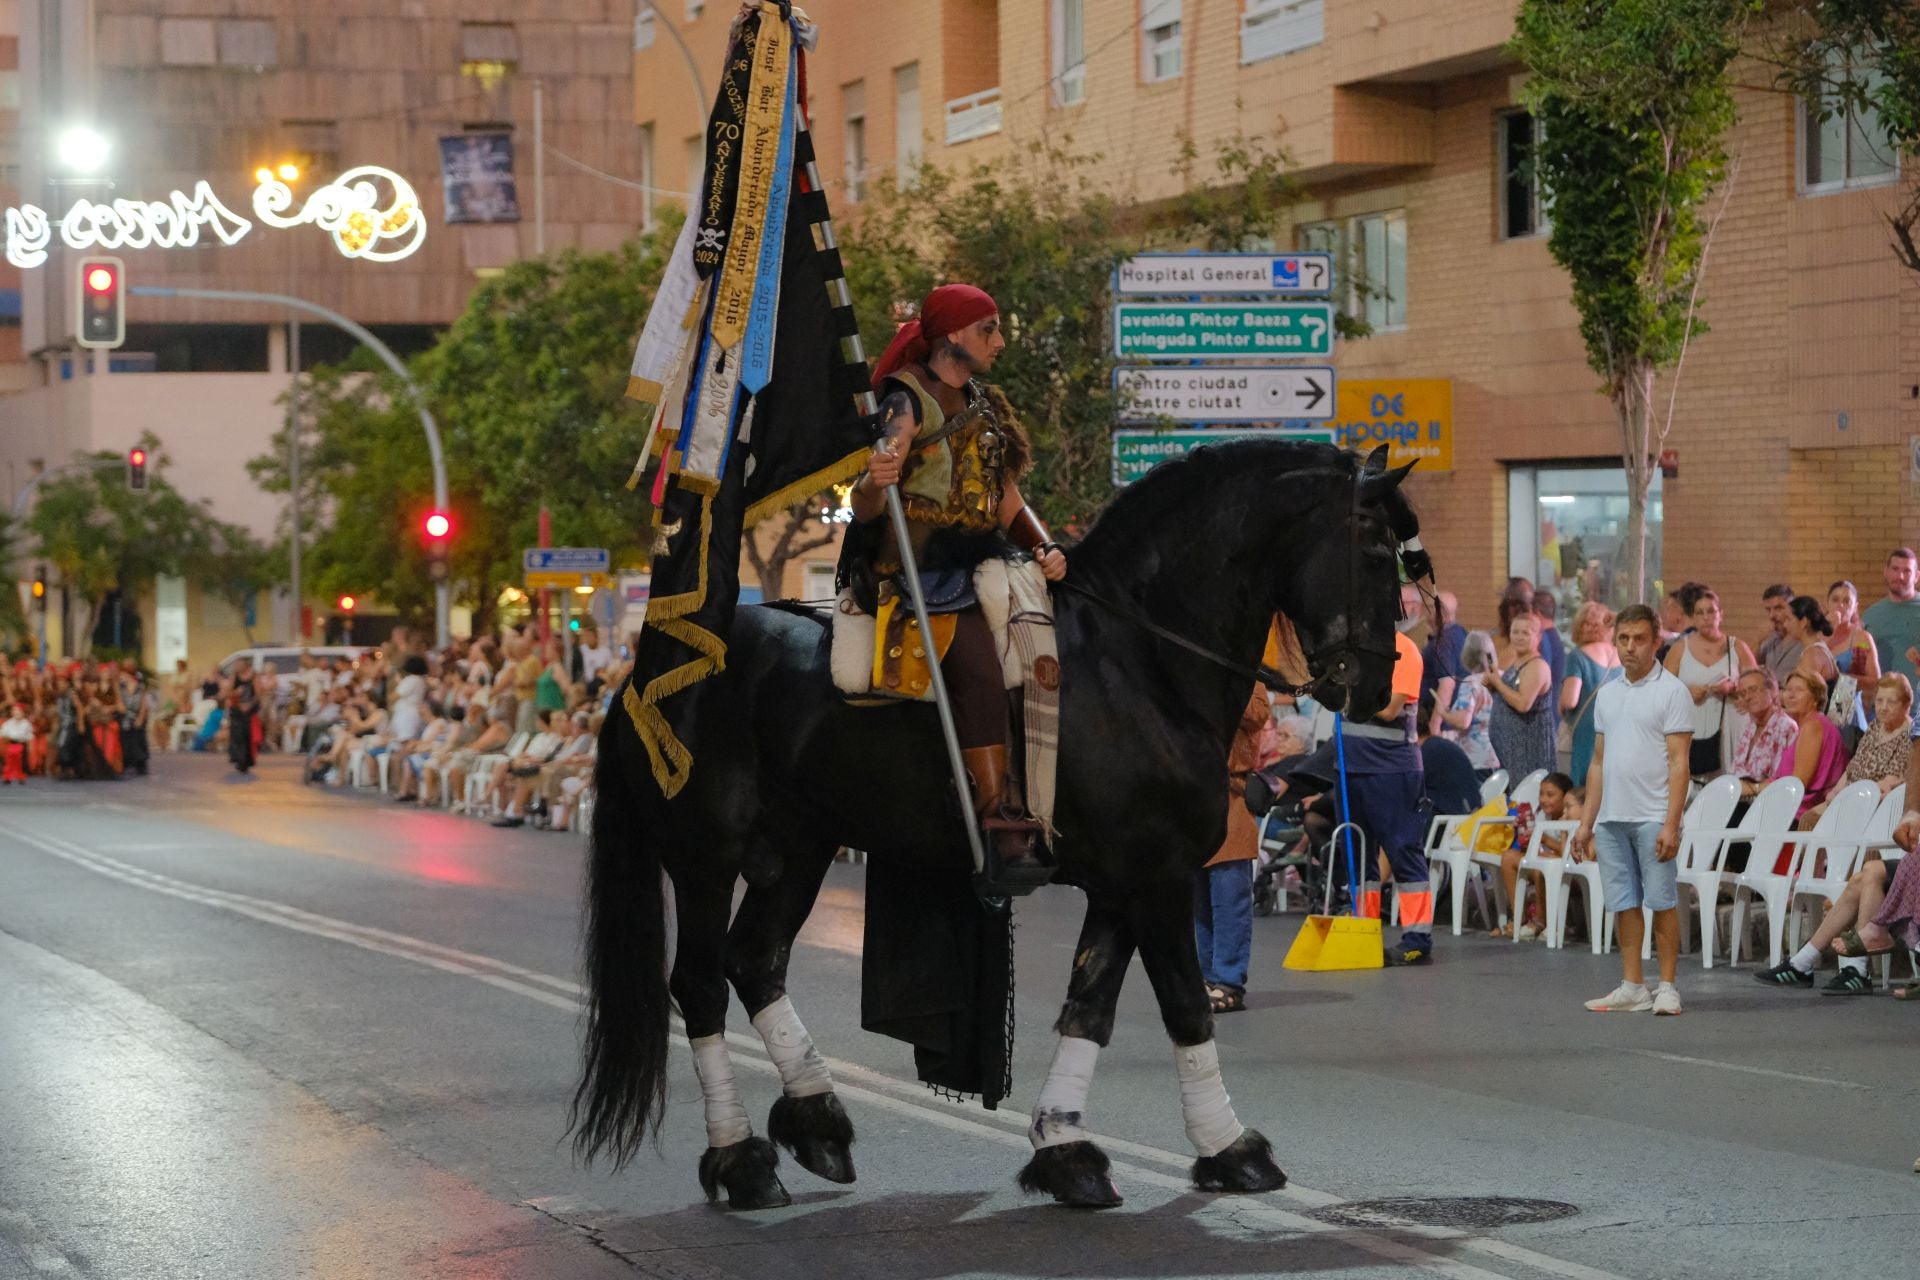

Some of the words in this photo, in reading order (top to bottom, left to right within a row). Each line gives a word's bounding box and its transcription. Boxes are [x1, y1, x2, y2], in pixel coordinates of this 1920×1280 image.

[714, 121, 740, 140] 70
[706, 140, 731, 226] ANIVERSARIO
[748, 125, 770, 219] Abanderado
[695, 249, 720, 264] 2024
[735, 224, 755, 275] Mayor
[1121, 265, 1195, 284] Hospital
[1202, 265, 1267, 281] General
[726, 289, 742, 326] 2016
[751, 283, 771, 369] 2015-2016
[1122, 313, 1186, 328] avenida
[1190, 313, 1239, 328] Pintor
[1244, 313, 1291, 328] Baeza
[1122, 333, 1197, 350] avinguda
[1201, 333, 1250, 347] Pintor
[1255, 333, 1302, 347] Baeza
[1188, 376, 1248, 390] ciudad
[708, 373, 729, 418] 2006
[1188, 395, 1243, 409] ciutat
[1371, 393, 1405, 418] DE
[1336, 421, 1420, 446] HOGAR
[1395, 444, 1441, 459] precio
